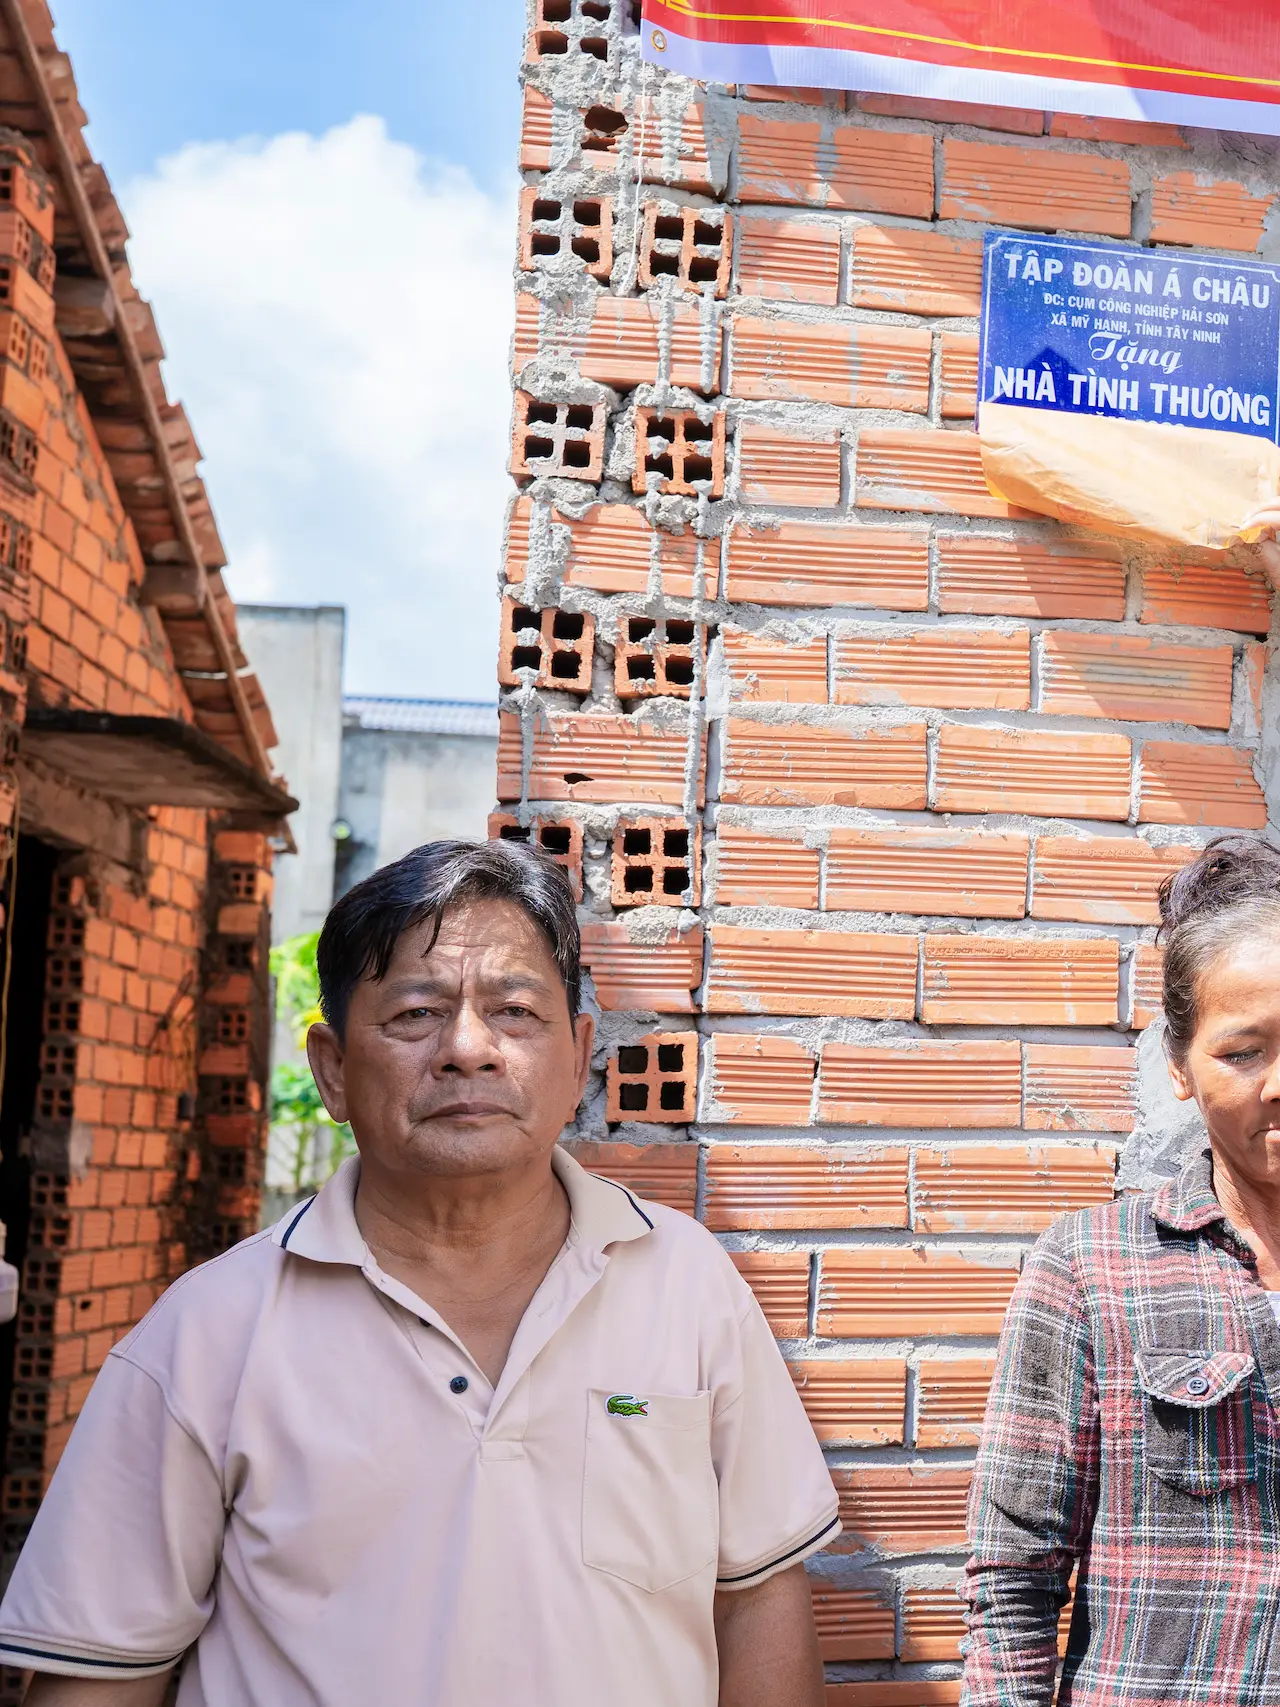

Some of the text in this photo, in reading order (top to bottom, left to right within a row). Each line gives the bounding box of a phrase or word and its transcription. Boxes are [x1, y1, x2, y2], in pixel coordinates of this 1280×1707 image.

[1004, 250, 1270, 309] TẬP ĐOÀN Á CHÂU
[1043, 293, 1229, 326] ĐC: CỤM CÔNG NGHIỆP HẢI SƠN
[1050, 312, 1067, 326] XÃ
[1071, 314, 1090, 329] MỸ
[1134, 320, 1163, 337] TỈNH
[1166, 325, 1190, 340] TÂY
[1193, 330, 1221, 344] NINH
[1087, 331, 1184, 375] Tặng
[993, 362, 1271, 427] NHÀ TÌNH THƯƠNG
